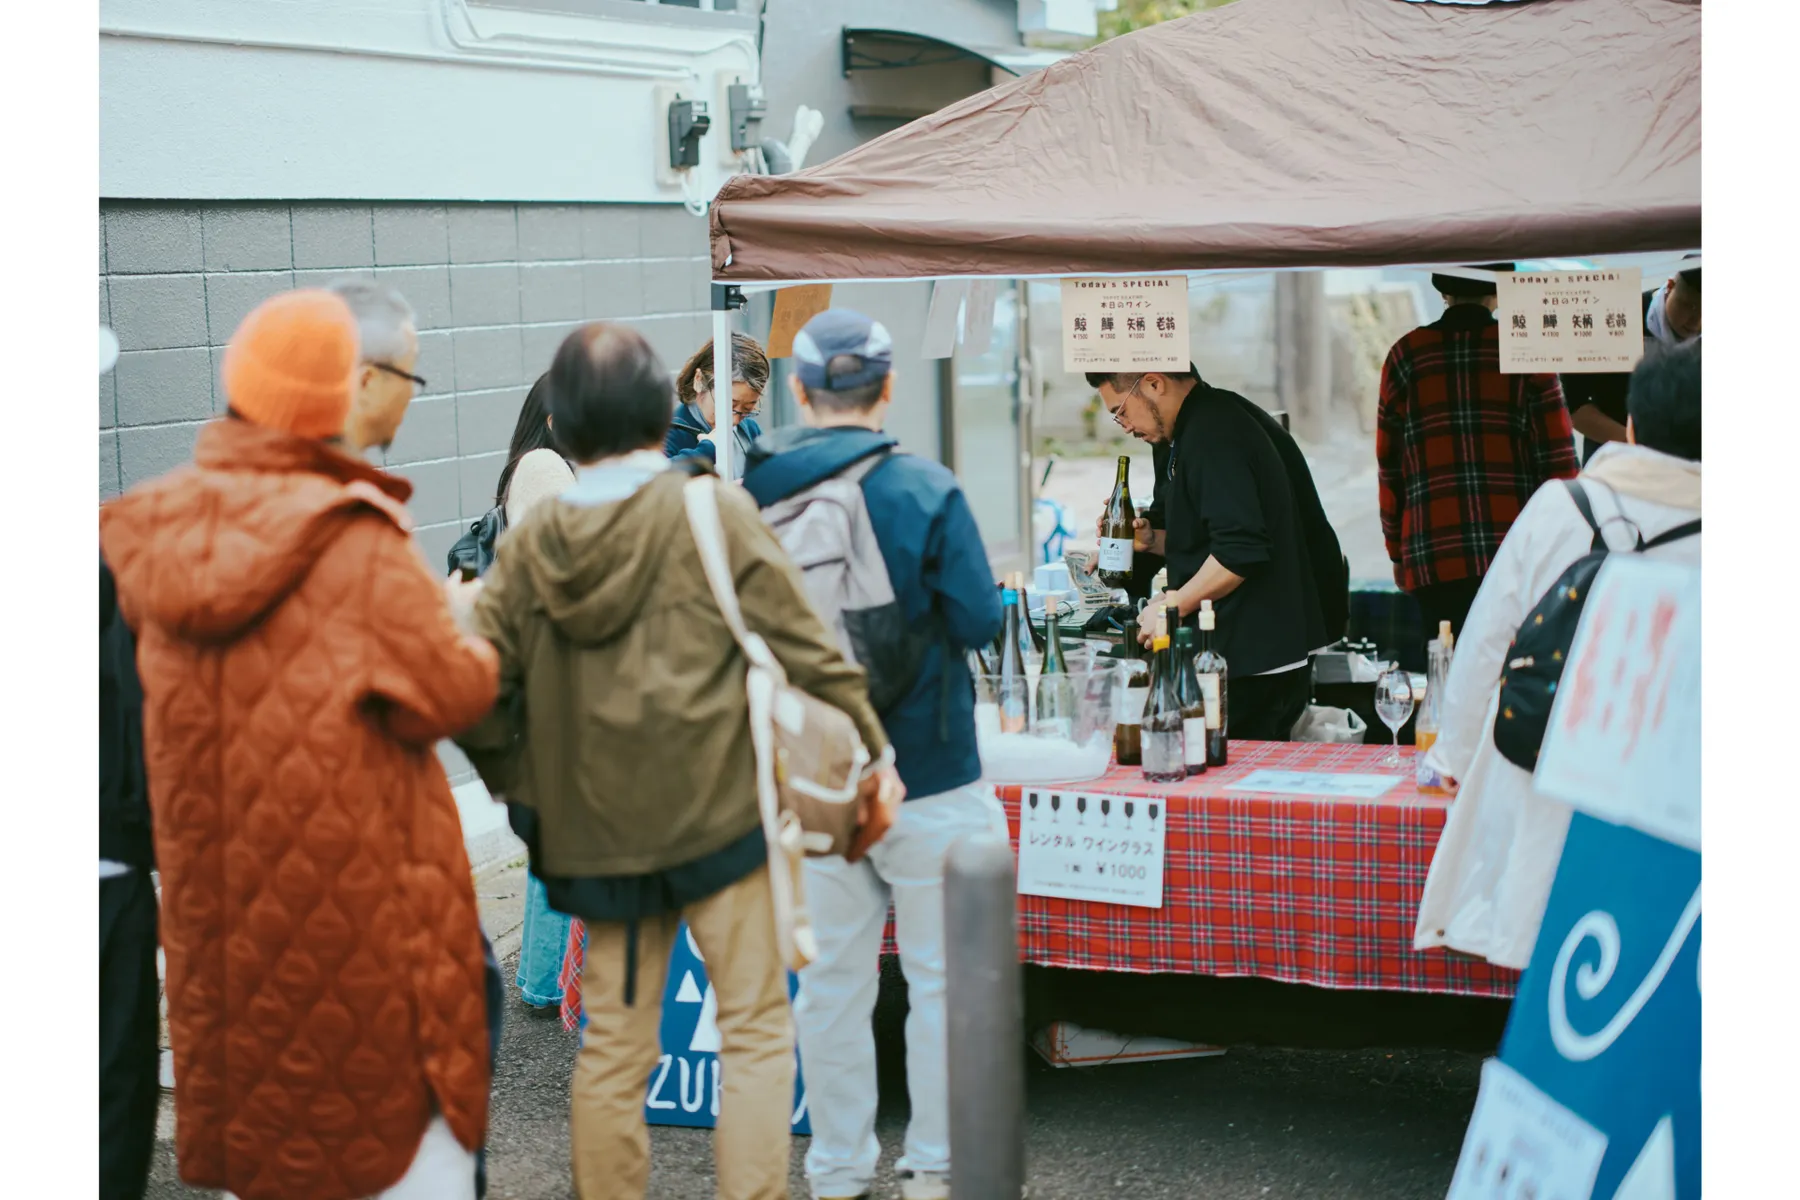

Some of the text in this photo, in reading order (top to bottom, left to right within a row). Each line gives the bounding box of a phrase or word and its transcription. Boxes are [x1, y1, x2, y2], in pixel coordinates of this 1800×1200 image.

[1074, 280, 1170, 289] Today's SPECIAL
[1512, 276, 1560, 284] Today's
[1100, 301, 1152, 309] 本日のワイン
[1543, 297, 1599, 306] 本日のワイン
[1029, 829, 1154, 856] レンタル ワイングラス
[1096, 861, 1147, 880] ¥1000
